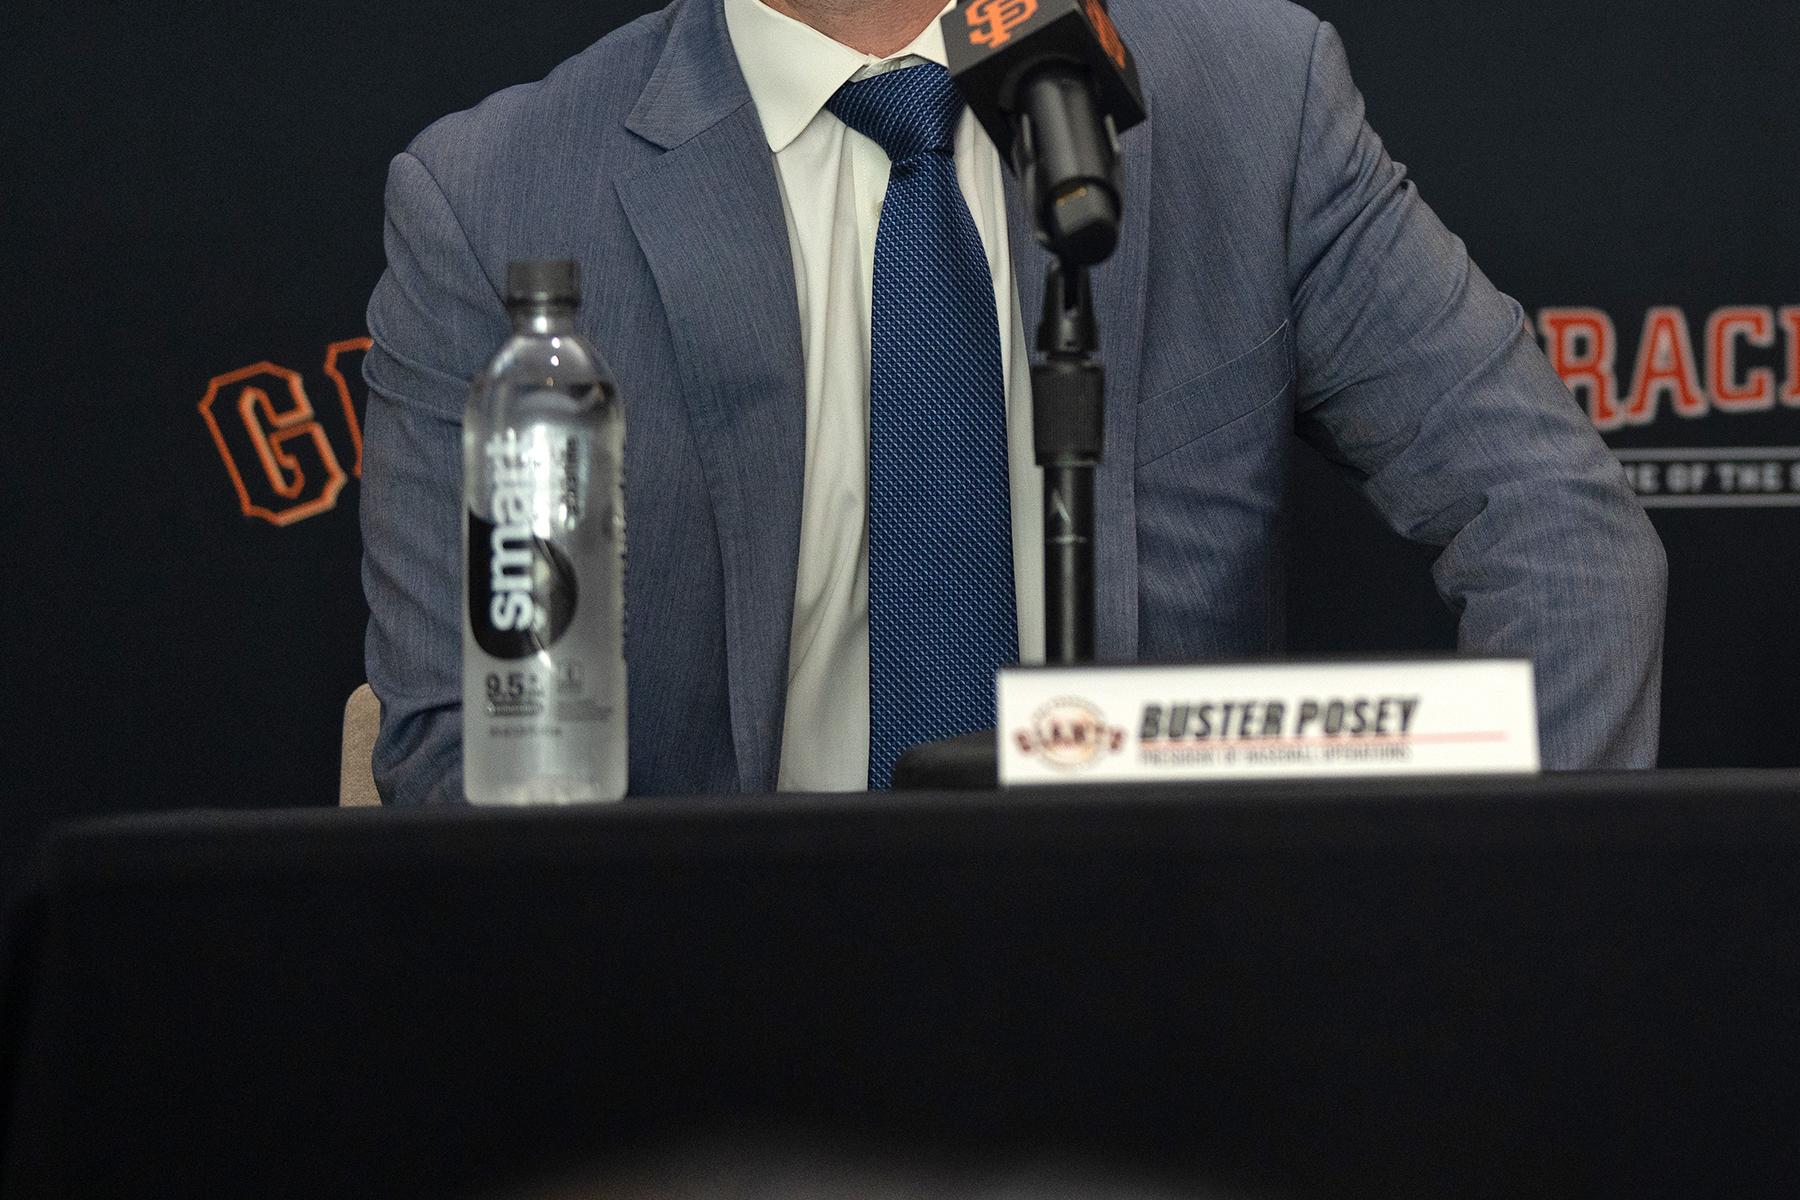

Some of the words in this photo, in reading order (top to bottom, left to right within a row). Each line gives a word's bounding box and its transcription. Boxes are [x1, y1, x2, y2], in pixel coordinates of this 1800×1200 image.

[1666, 462, 1709, 494] OF
[1716, 462, 1783, 493] THE
[1140, 701, 1287, 741] BUSTER
[1293, 697, 1421, 737] POSEY
